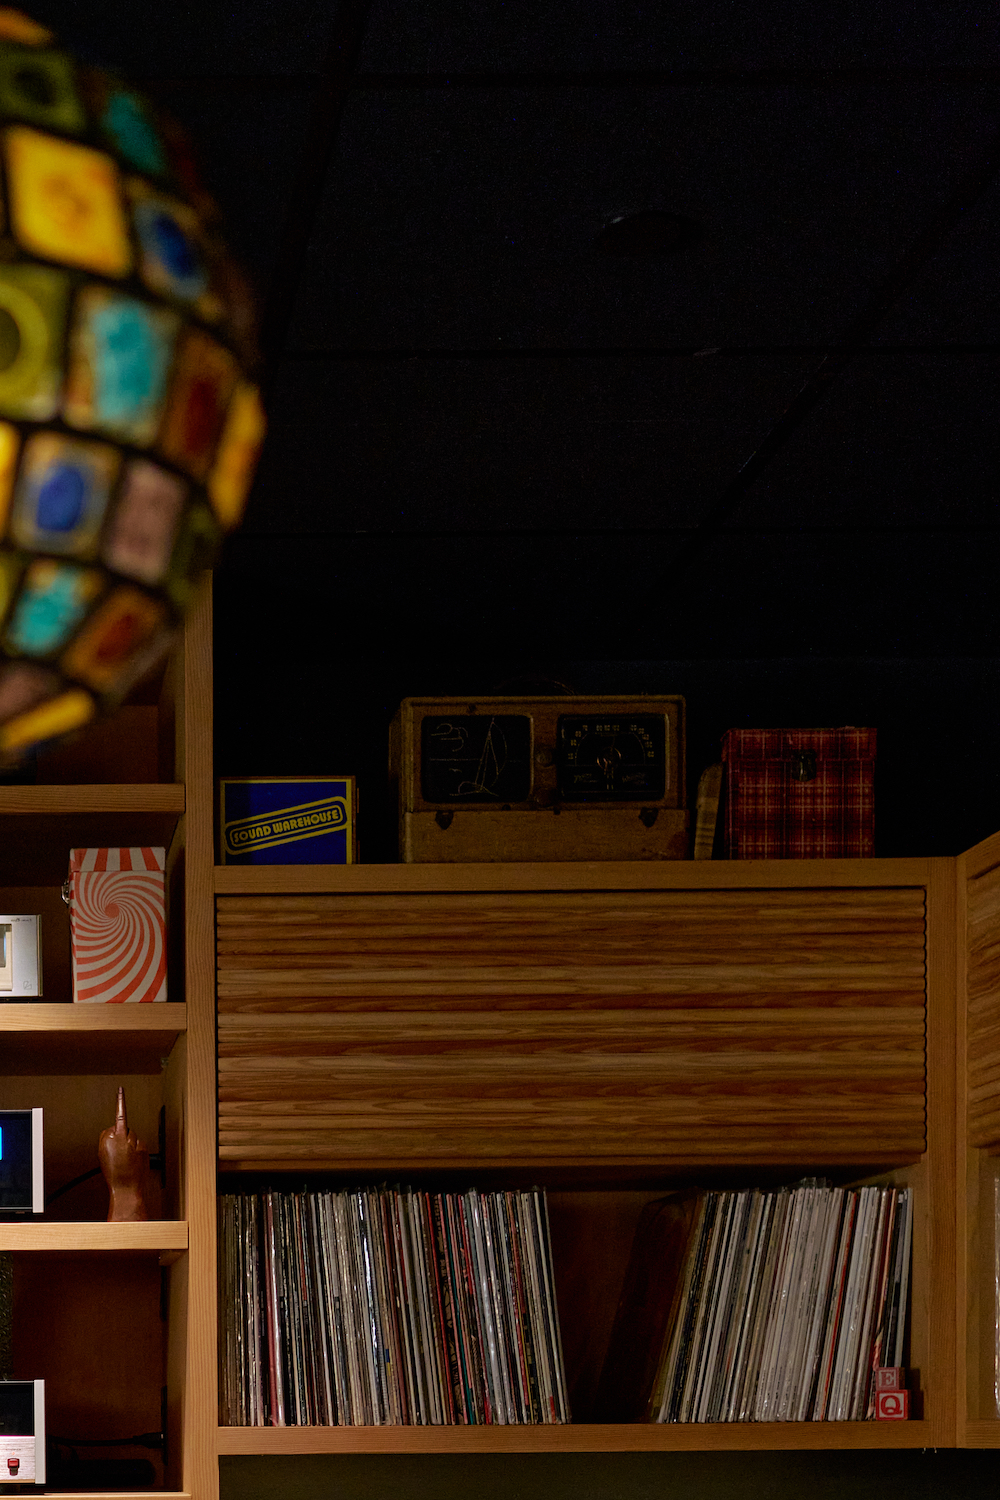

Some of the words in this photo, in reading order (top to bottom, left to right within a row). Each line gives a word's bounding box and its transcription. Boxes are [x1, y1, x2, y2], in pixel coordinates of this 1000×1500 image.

[233, 825, 272, 843] SOUND
[272, 809, 339, 834] WAREHOUSE
[881, 1395, 902, 1415] Q
